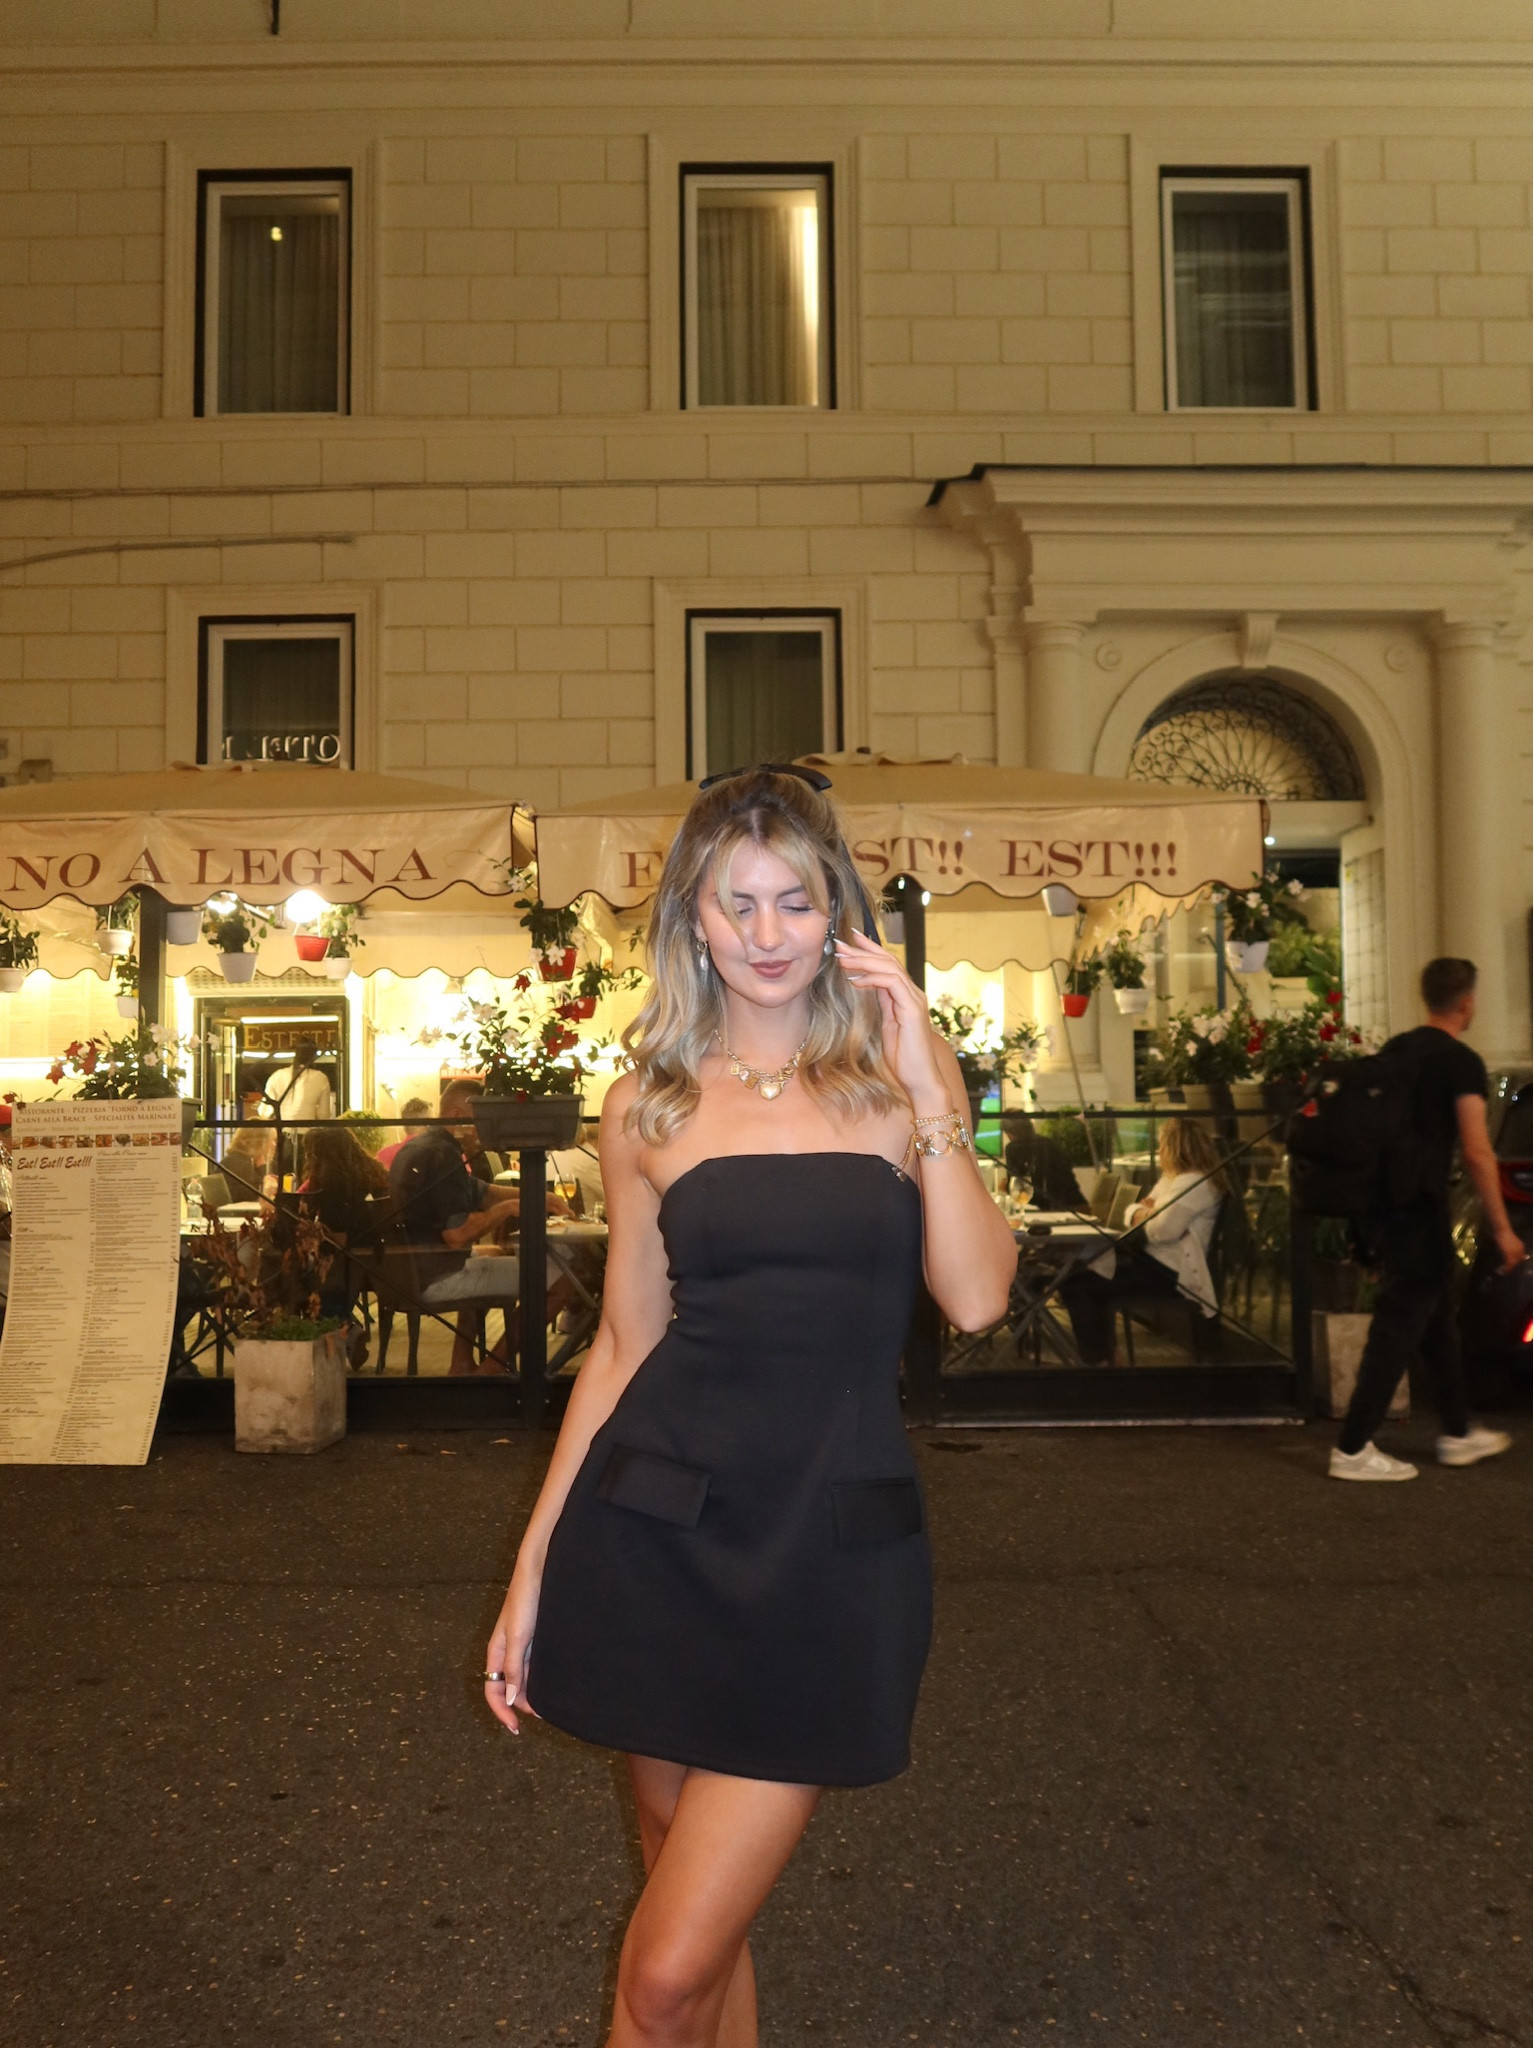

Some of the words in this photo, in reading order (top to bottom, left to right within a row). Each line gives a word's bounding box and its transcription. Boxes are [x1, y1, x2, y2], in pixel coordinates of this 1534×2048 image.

[852, 836, 964, 877] ST!!
[999, 839, 1177, 878] EST!!!
[119, 847, 170, 884] A
[190, 847, 438, 887] LEGNA
[72, 1106, 106, 1114] PIZZERIA
[137, 1113, 177, 1121] MARINARE
[17, 1157, 39, 1170] Est!
[39, 1156, 64, 1170] Est!!
[65, 1155, 93, 1169] Est!!!
